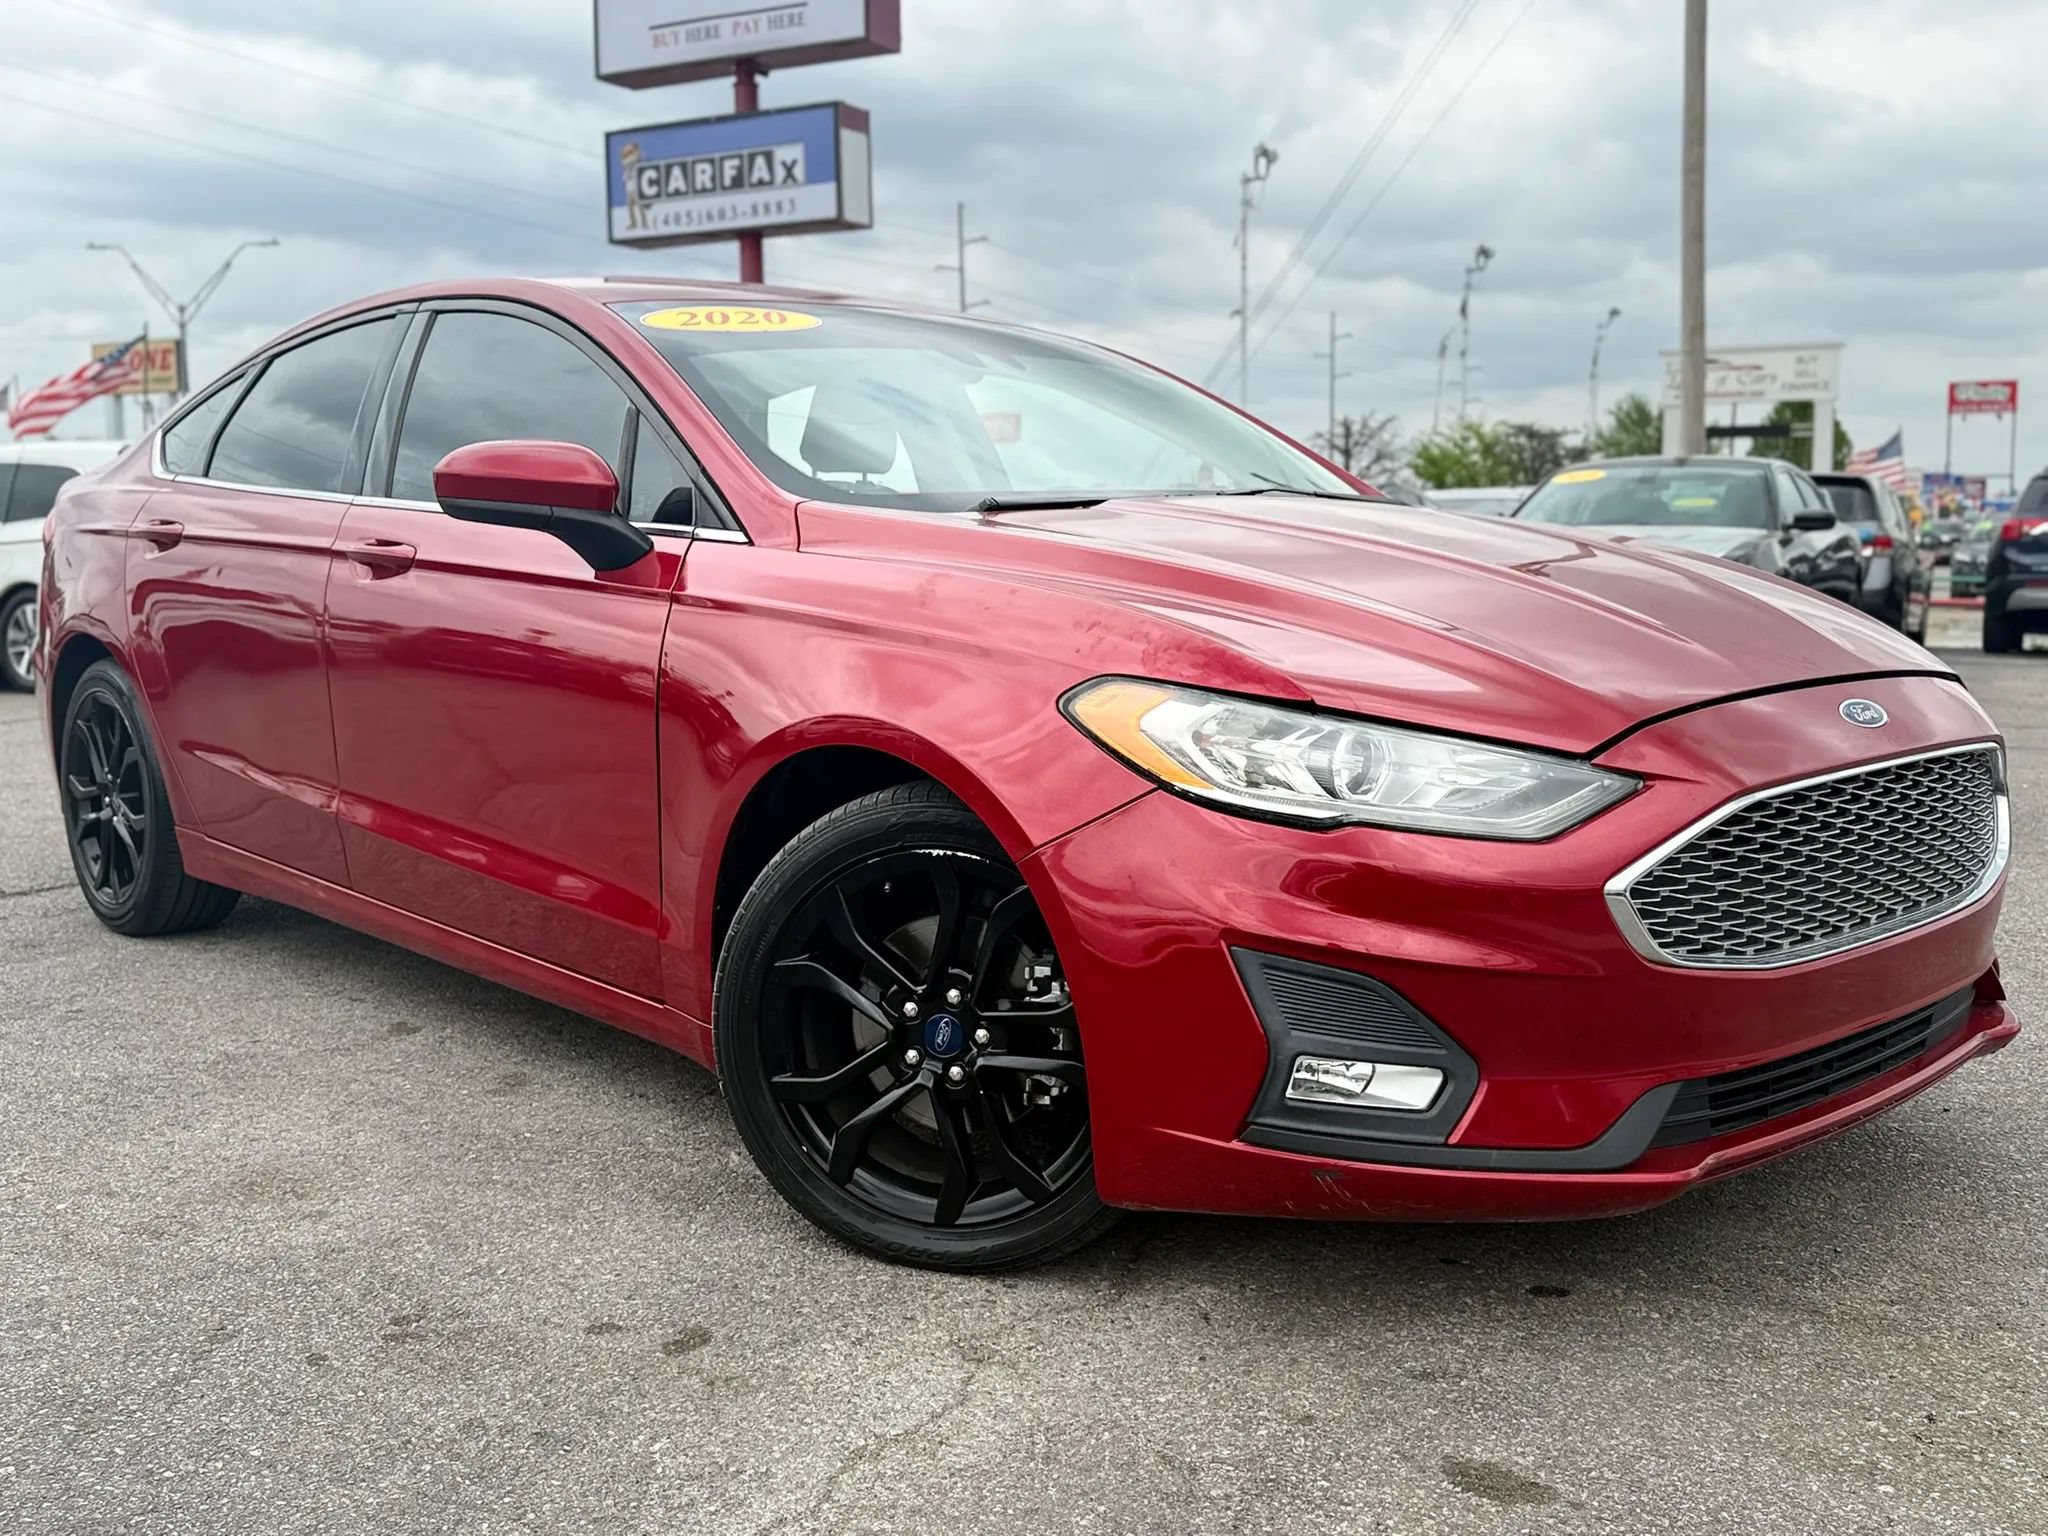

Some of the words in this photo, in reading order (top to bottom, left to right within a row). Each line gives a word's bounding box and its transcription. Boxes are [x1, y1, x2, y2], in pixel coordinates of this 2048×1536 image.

[652, 31, 680, 48] BUY
[685, 24, 721, 43] HERE
[732, 18, 760, 36] PAY
[767, 11, 805, 30] HERE
[639, 153, 799, 198] CARFAX
[676, 311, 788, 327] 2020
[1849, 704, 1879, 721] Ford
